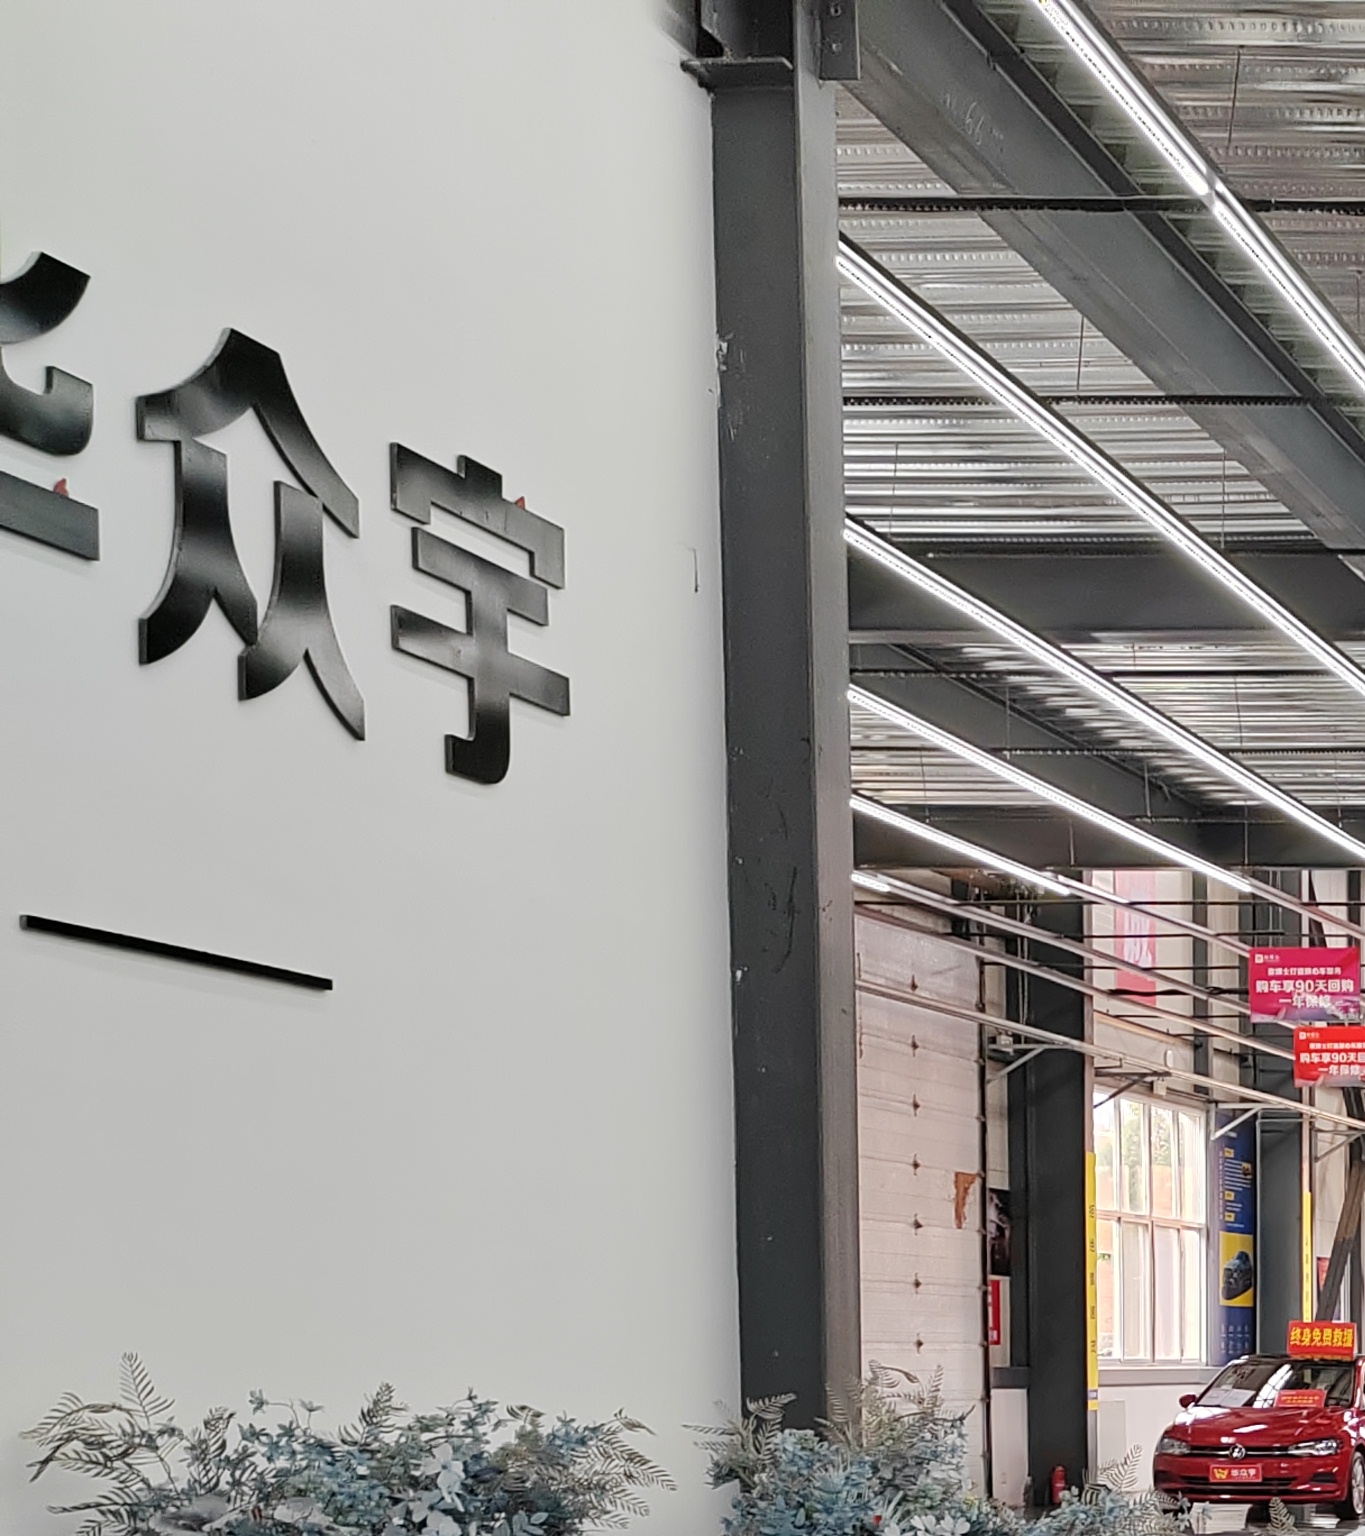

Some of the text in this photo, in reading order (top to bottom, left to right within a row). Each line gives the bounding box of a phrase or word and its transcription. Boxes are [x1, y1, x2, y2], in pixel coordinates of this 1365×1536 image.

[1256, 979, 1354, 993] 购车享90天回购
[1279, 995, 1331, 1008] 一年保修
[1290, 1327, 1353, 1347] 终身免费救援
